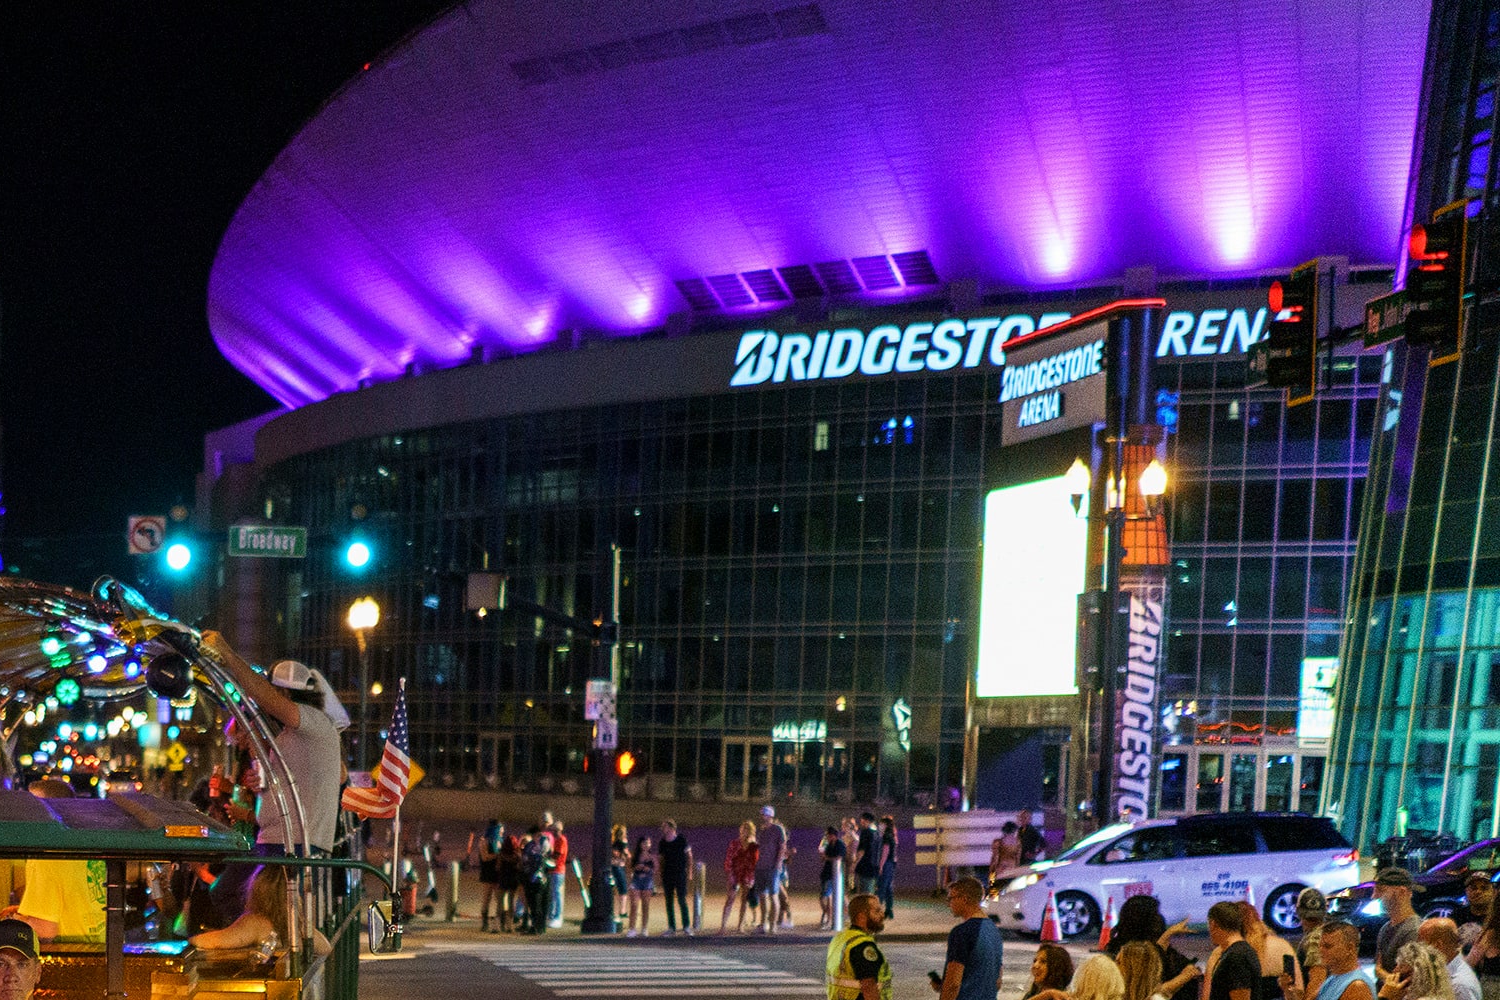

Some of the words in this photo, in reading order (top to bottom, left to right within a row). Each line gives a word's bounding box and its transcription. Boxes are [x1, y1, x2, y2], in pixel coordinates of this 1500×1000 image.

[730, 312, 1072, 387] BRIDGESTO
[1155, 306, 1292, 357] REN
[1000, 339, 1105, 403] BRIDGESTONE
[1019, 389, 1061, 428] ARENA
[239, 528, 296, 555] Broadway
[1118, 594, 1164, 825] BRIDGESTO
